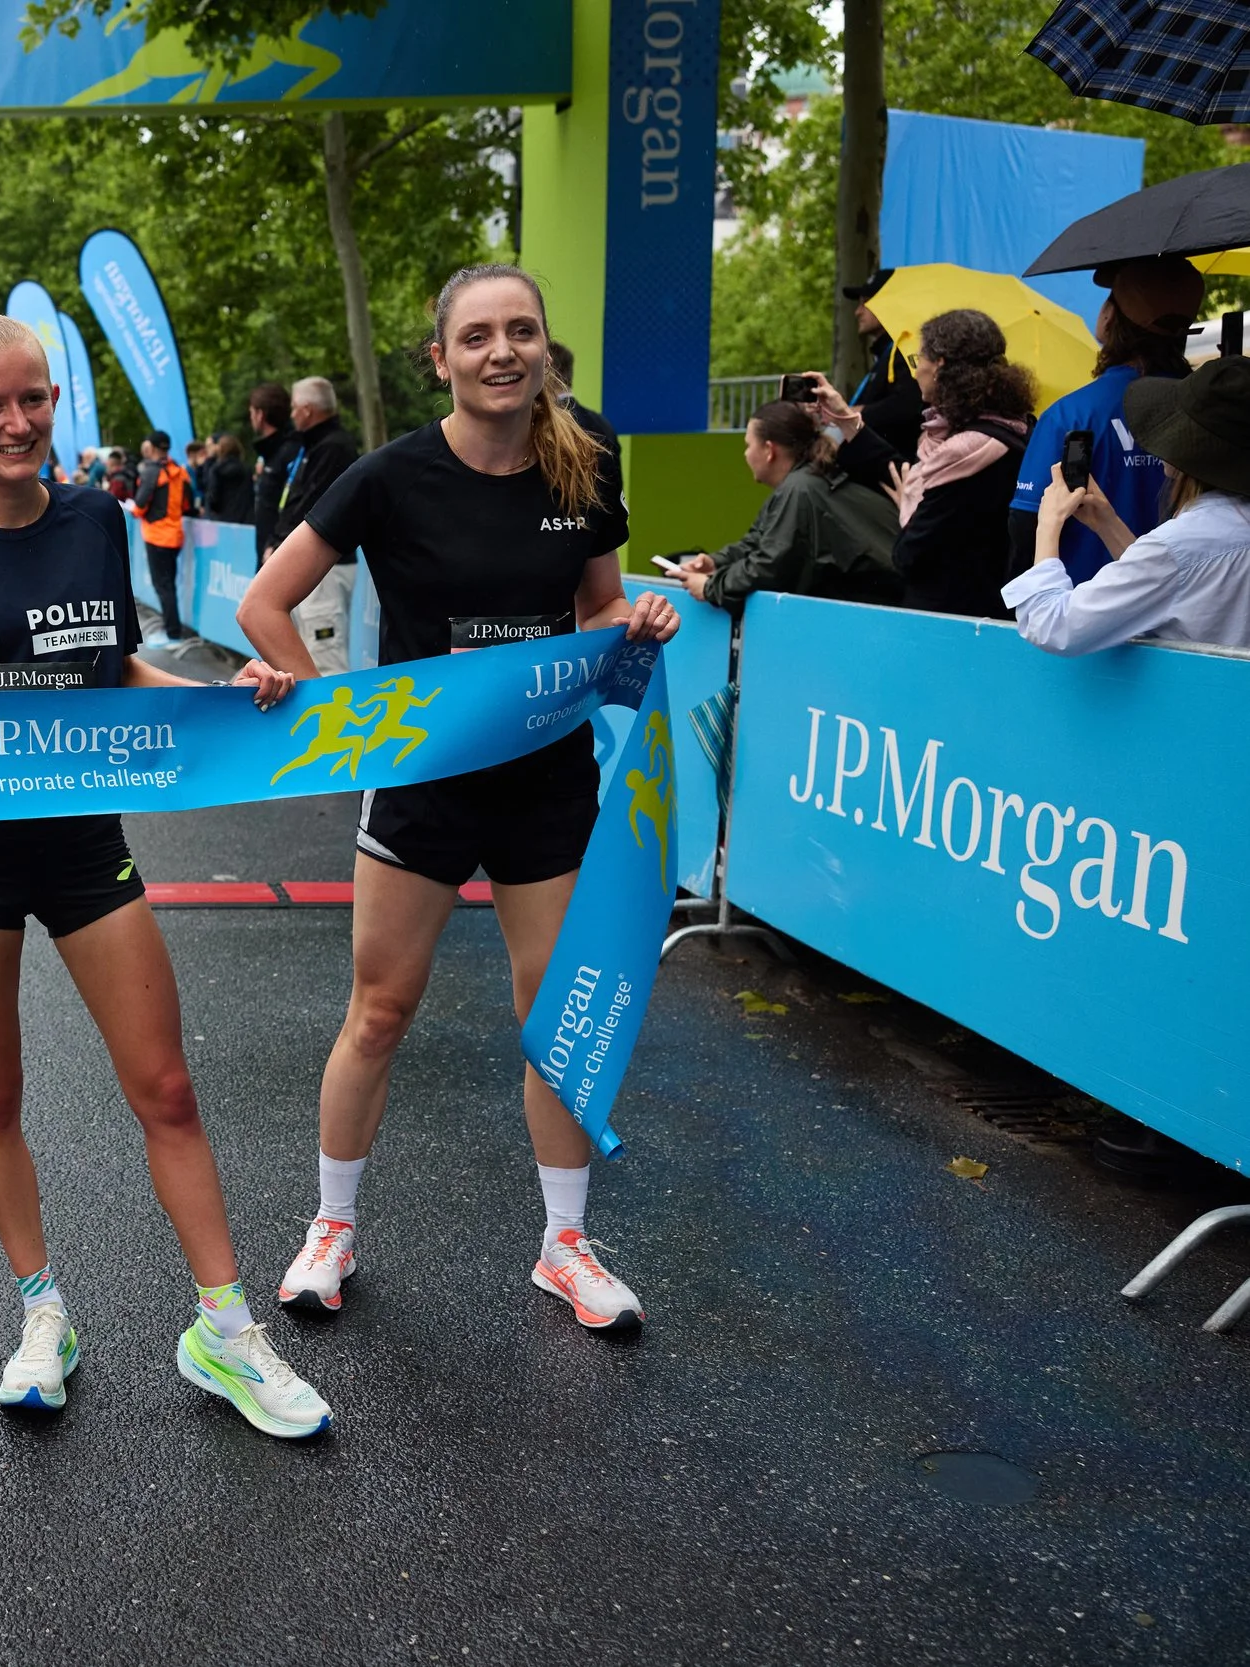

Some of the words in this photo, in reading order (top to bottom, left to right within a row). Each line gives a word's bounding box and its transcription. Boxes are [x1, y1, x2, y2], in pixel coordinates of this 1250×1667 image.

[623, 0, 697, 210] organ
[26, 600, 115, 631] POLIZEI
[468, 624, 551, 641] J.P.Morgan
[789, 706, 1189, 944] J.P.Morgan
